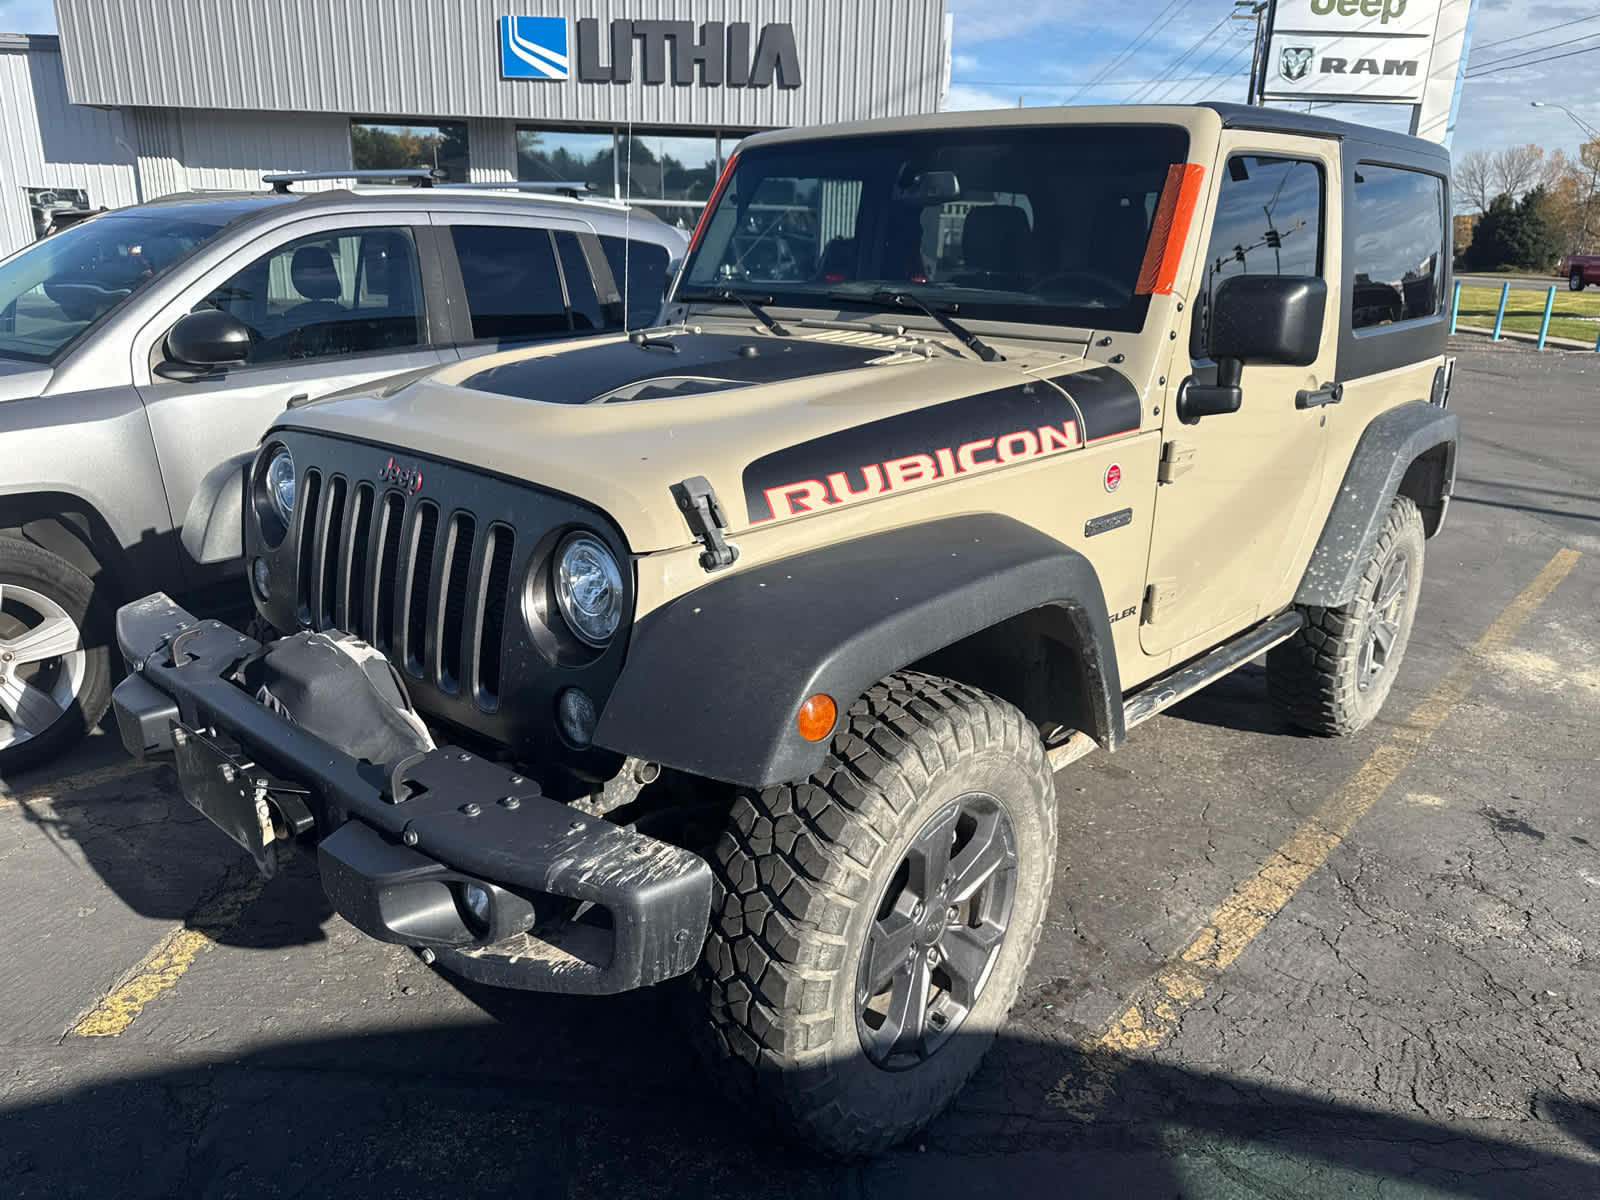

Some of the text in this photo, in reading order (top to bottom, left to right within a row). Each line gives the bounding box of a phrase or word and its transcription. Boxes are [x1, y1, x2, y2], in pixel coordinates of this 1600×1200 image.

[576, 18, 801, 90] LITHIA
[1320, 57, 1418, 76] RAM
[378, 457, 423, 496] Jeep
[763, 420, 1078, 519] RUBICON
